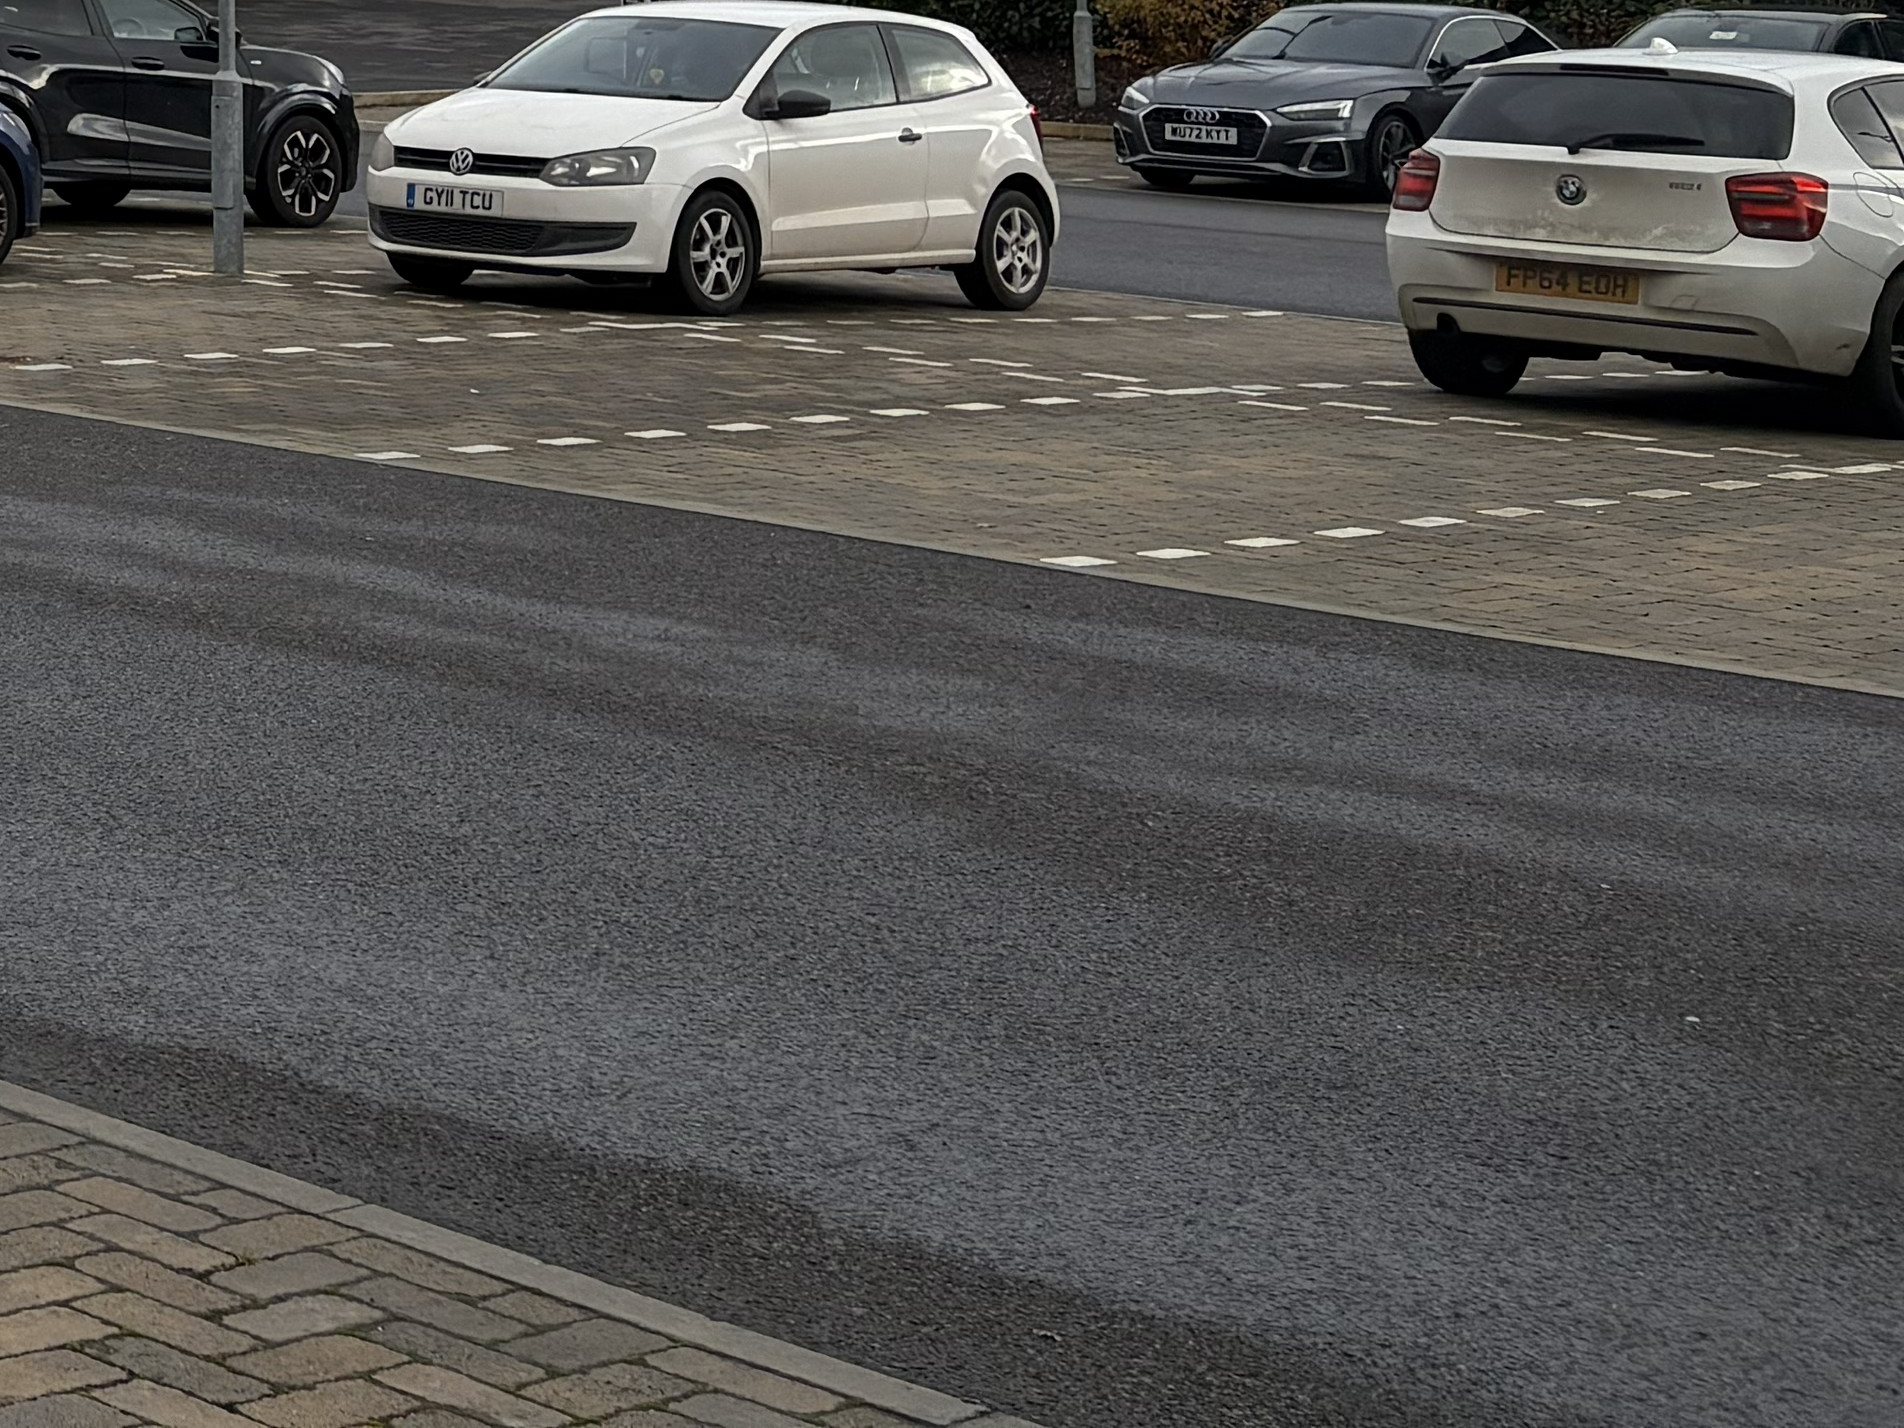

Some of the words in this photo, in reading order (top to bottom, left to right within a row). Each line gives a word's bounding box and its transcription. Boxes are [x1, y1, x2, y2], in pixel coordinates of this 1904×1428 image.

[1205, 128, 1231, 141] KYT
[423, 187, 454, 208] GY11
[459, 190, 493, 211] TCU
[1506, 265, 1570, 292] FP64
[1578, 272, 1629, 298] EOH
